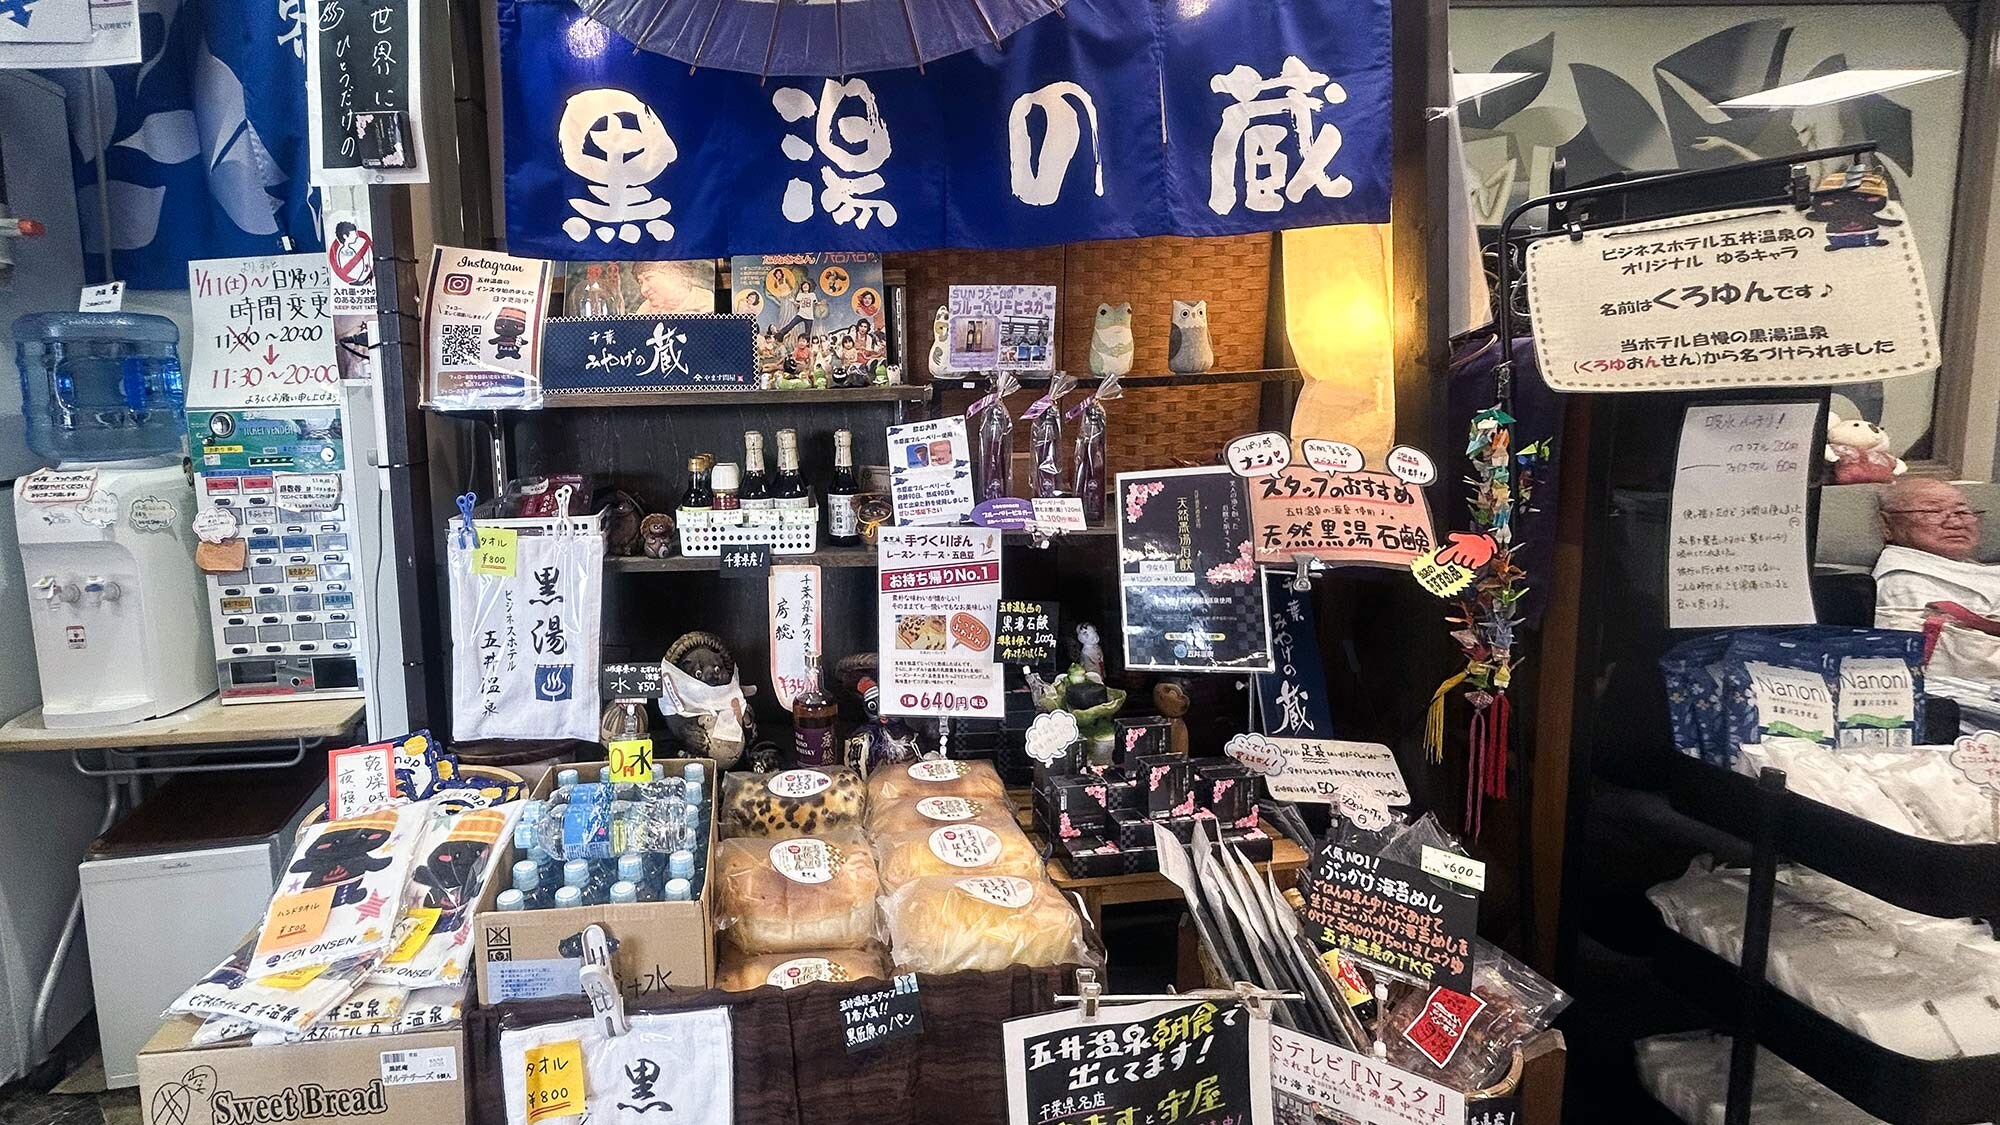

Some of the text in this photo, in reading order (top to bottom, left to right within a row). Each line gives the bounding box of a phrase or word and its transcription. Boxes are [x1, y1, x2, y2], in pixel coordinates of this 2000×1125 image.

[370, 6, 396, 107] 世界に
[557, 55, 1353, 244] 黒湯の蔵
[1602, 226, 1815, 261] ビジネスホテル五井温泉の
[457, 256, 524, 276] Instagram
[1621, 246, 1799, 276] オリジナル ゆるキャラ
[230, 291, 332, 326] 時間変更
[585, 322, 689, 377] みやげの蔵
[589, 331, 617, 346] 千葉
[1620, 325, 1829, 352] 当ホテル自慢の黒湯温泉
[1573, 339, 1896, 373] (くろゆおんせん)から名づけられました
[1260, 476, 1415, 505] スタッフのおすすめ
[481, 536, 508, 548] タオル
[904, 534, 974, 548] 手づくりぱん
[1262, 519, 1430, 553] 天然黒湯石鹸
[482, 553, 506, 565] ¥800
[889, 566, 989, 589] お持ち帰りNo.1
[529, 566, 568, 656] 黒湯
[800, 574, 815, 654] 千葉県産ウィス
[504, 590, 518, 672] ビジネスホテル
[480, 631, 502, 717] 五井温泉
[610, 676, 632, 694] 水
[1271, 613, 1316, 735] みやげの蔵
[1756, 676, 1828, 704] Nanoni
[1840, 671, 1909, 690] Nanoni
[920, 691, 968, 710] 640円
[1321, 927, 1436, 979] 五井温泉のTKG
[1028, 1002, 1239, 1071] 五井温泉朝食で
[525, 1055, 570, 1077] タオル
[211, 1079, 388, 1124] Sweet Bread
[528, 1085, 570, 1108] ¥800
[617, 1057, 674, 1114] 黒
[1038, 1092, 1106, 1118] 千葉県名店
